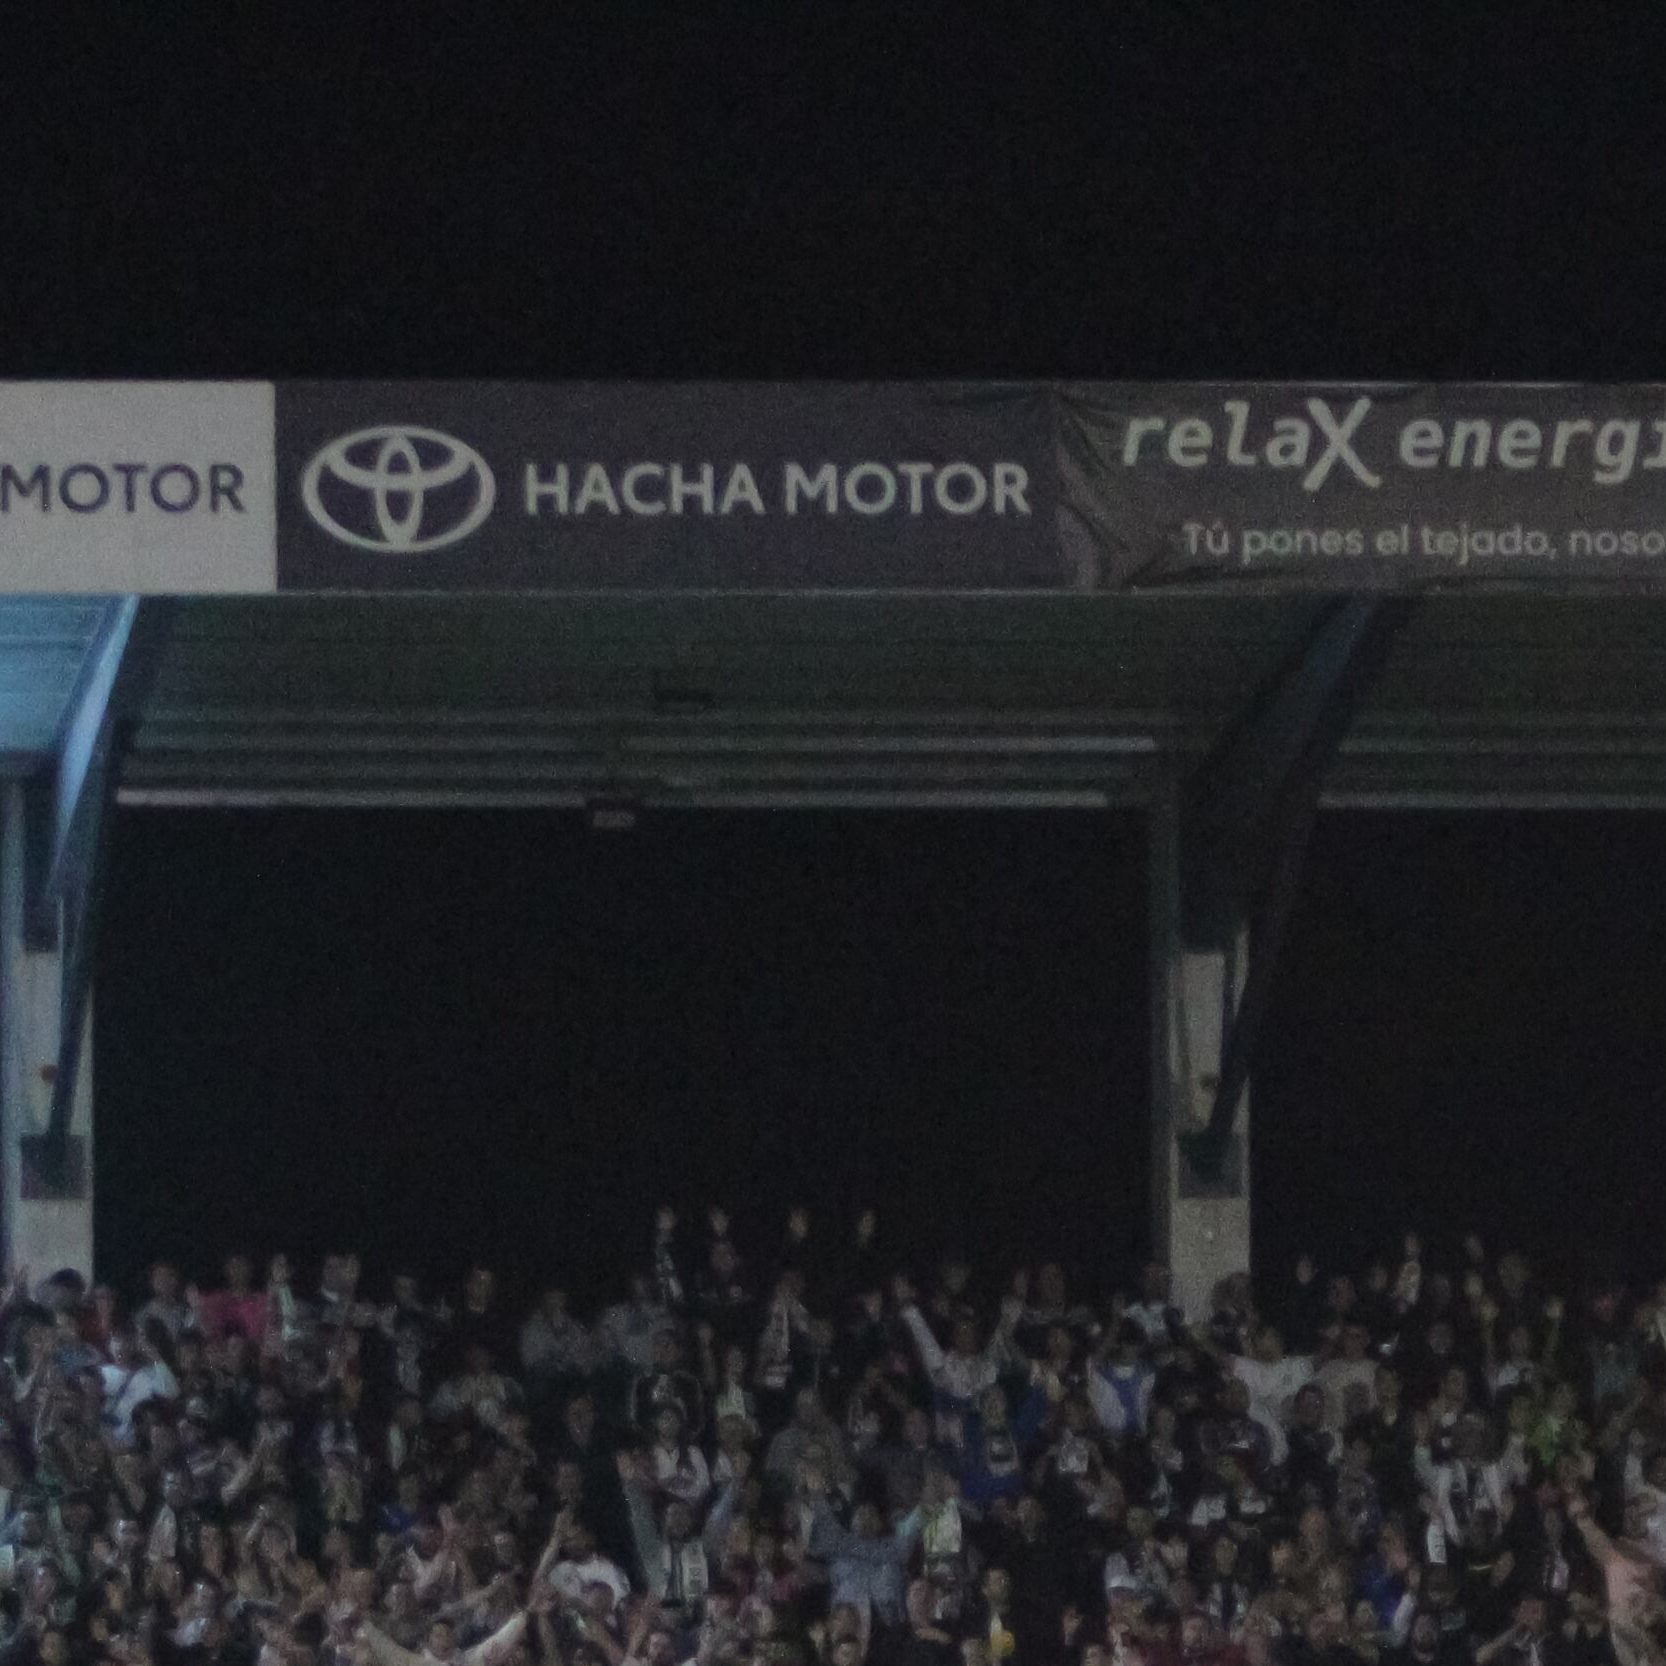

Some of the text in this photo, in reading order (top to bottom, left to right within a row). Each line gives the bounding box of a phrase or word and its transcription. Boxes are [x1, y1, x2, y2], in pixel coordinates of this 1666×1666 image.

[1122, 396, 1384, 492] relaX
[524, 462, 1033, 516] HACHA MOTOR
[1181, 522, 1230, 556] Tú
[1243, 526, 1364, 566] pones
[1375, 524, 1410, 556] el
[1420, 522, 1558, 567] tejado,
